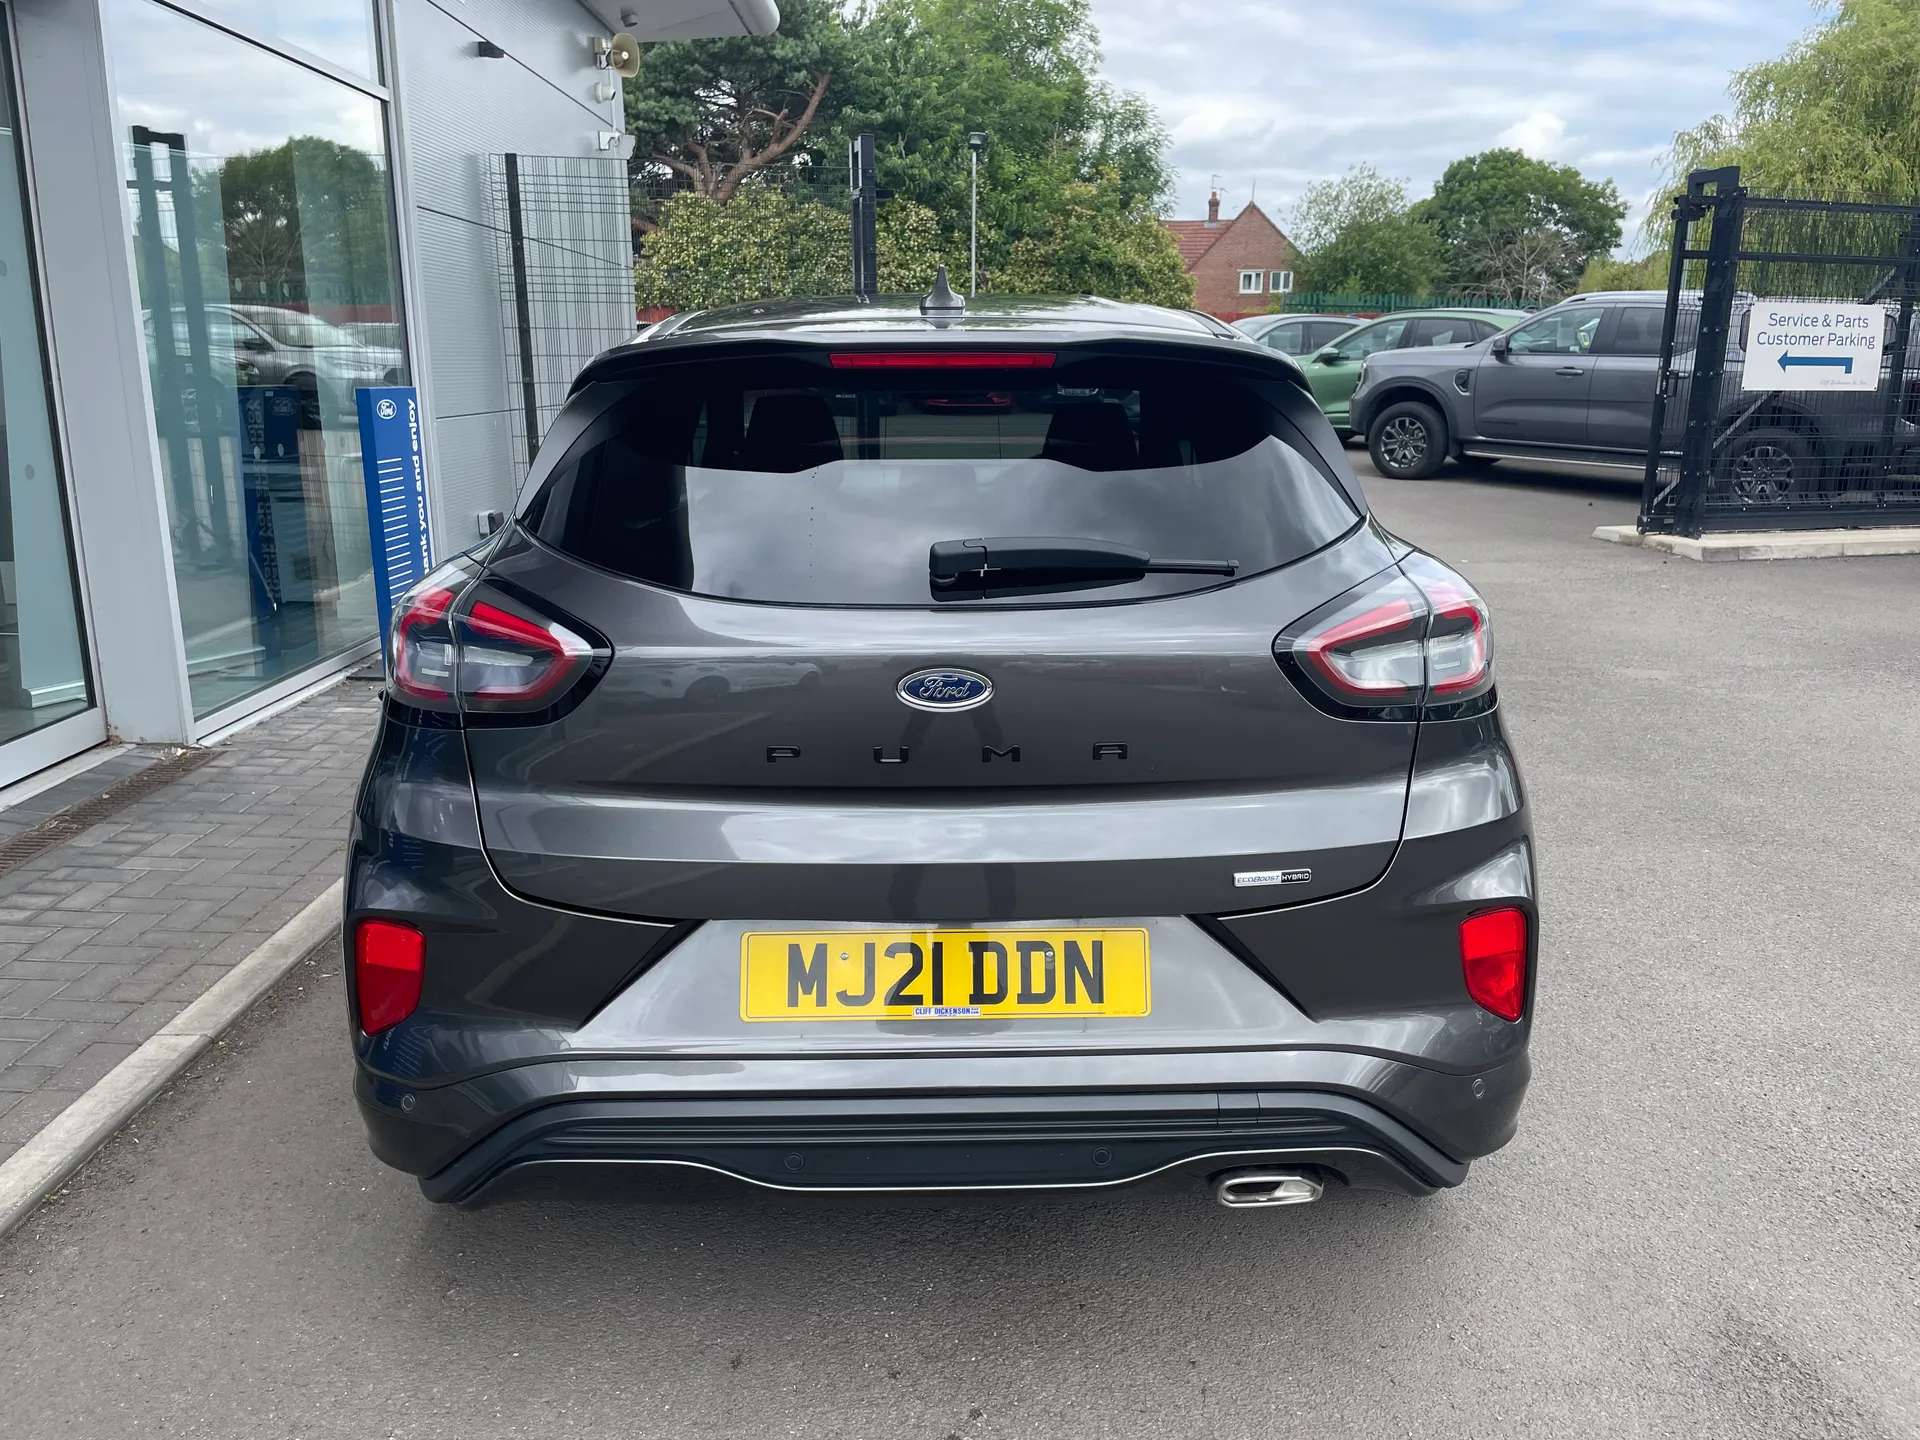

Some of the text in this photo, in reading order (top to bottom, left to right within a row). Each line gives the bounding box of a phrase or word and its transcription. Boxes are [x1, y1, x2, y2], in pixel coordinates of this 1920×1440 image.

[1768, 313, 1869, 329] Service & Parts
[1757, 331, 1875, 350] Customer Parking
[407, 398, 430, 575] ank you and enjoy
[919, 675, 970, 699] Ford
[766, 741, 1128, 764] PUMA
[1281, 873, 1310, 881] HYBRID
[787, 940, 1104, 1008] MJ21 DDN
